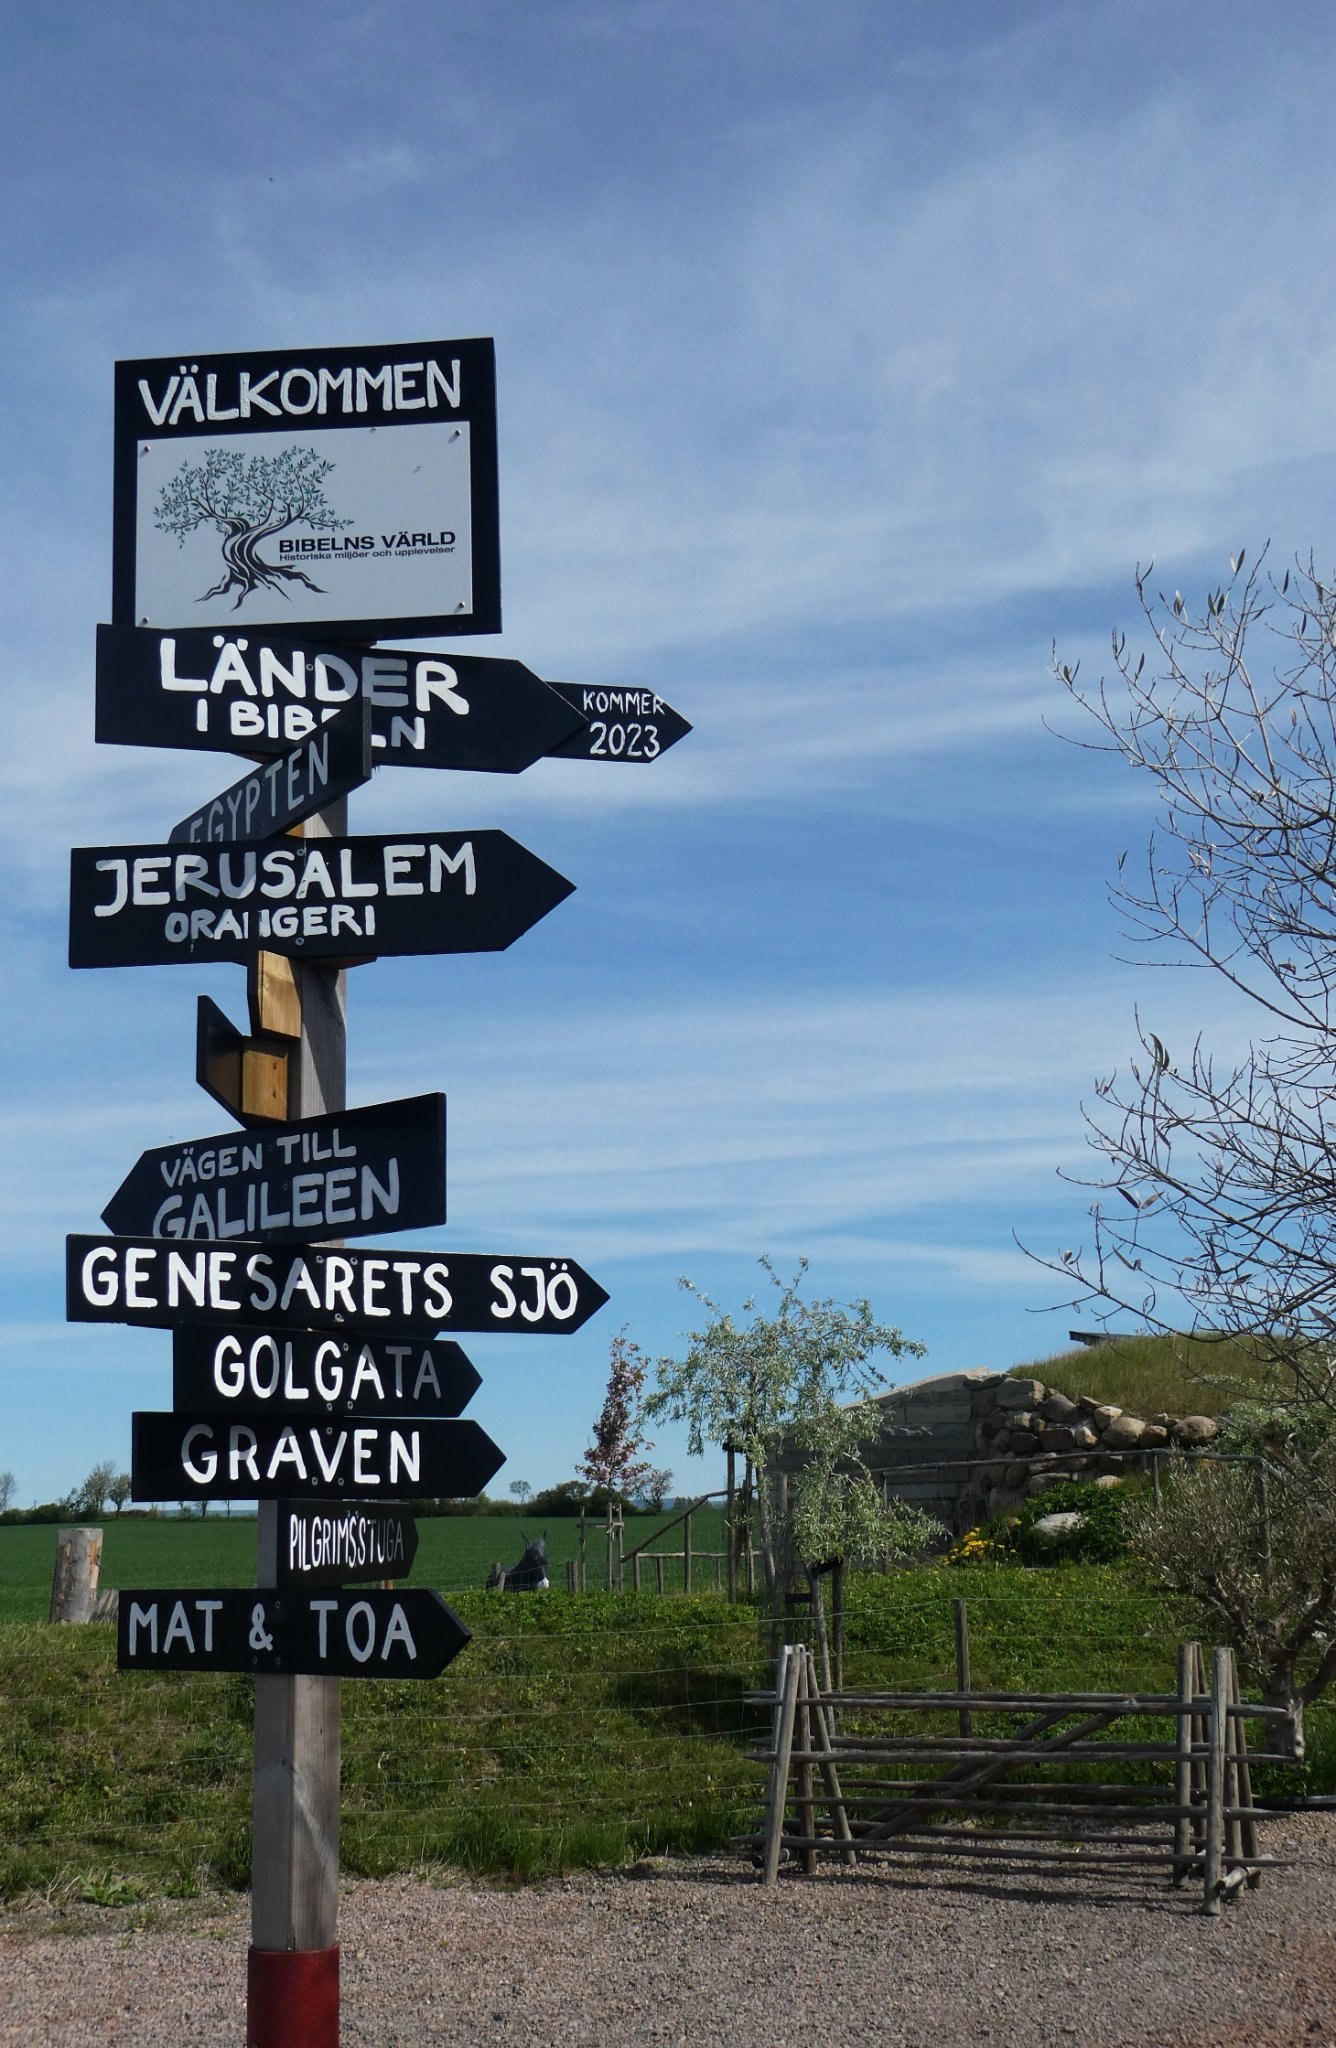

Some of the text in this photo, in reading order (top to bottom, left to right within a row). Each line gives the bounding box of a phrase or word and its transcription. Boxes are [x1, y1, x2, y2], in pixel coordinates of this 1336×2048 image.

[138, 359, 461, 426] VÄLKOMMEN
[279, 531, 456, 553] BIBELNS VÄRLD
[279, 546, 456, 562] Historiska miljöer och upplevelser
[160, 636, 470, 715] LÄNDER
[583, 689, 665, 716] KOMMER
[196, 698, 426, 750] I BIBN
[589, 721, 661, 758] 2023
[189, 732, 329, 844] EGYPTEN
[94, 841, 477, 917] JERUSALEM
[160, 1128, 357, 1188] VÄGEN TILL
[152, 1157, 400, 1241] GALILEEN
[82, 1246, 579, 1322] GENESARETS SJÖ
[214, 1335, 442, 1400] GOLGATA
[181, 1423, 421, 1484] GRAVEN
[290, 1513, 404, 1571] PILGRIMSSTUGA
[128, 1601, 417, 1663] MAT & TOA
